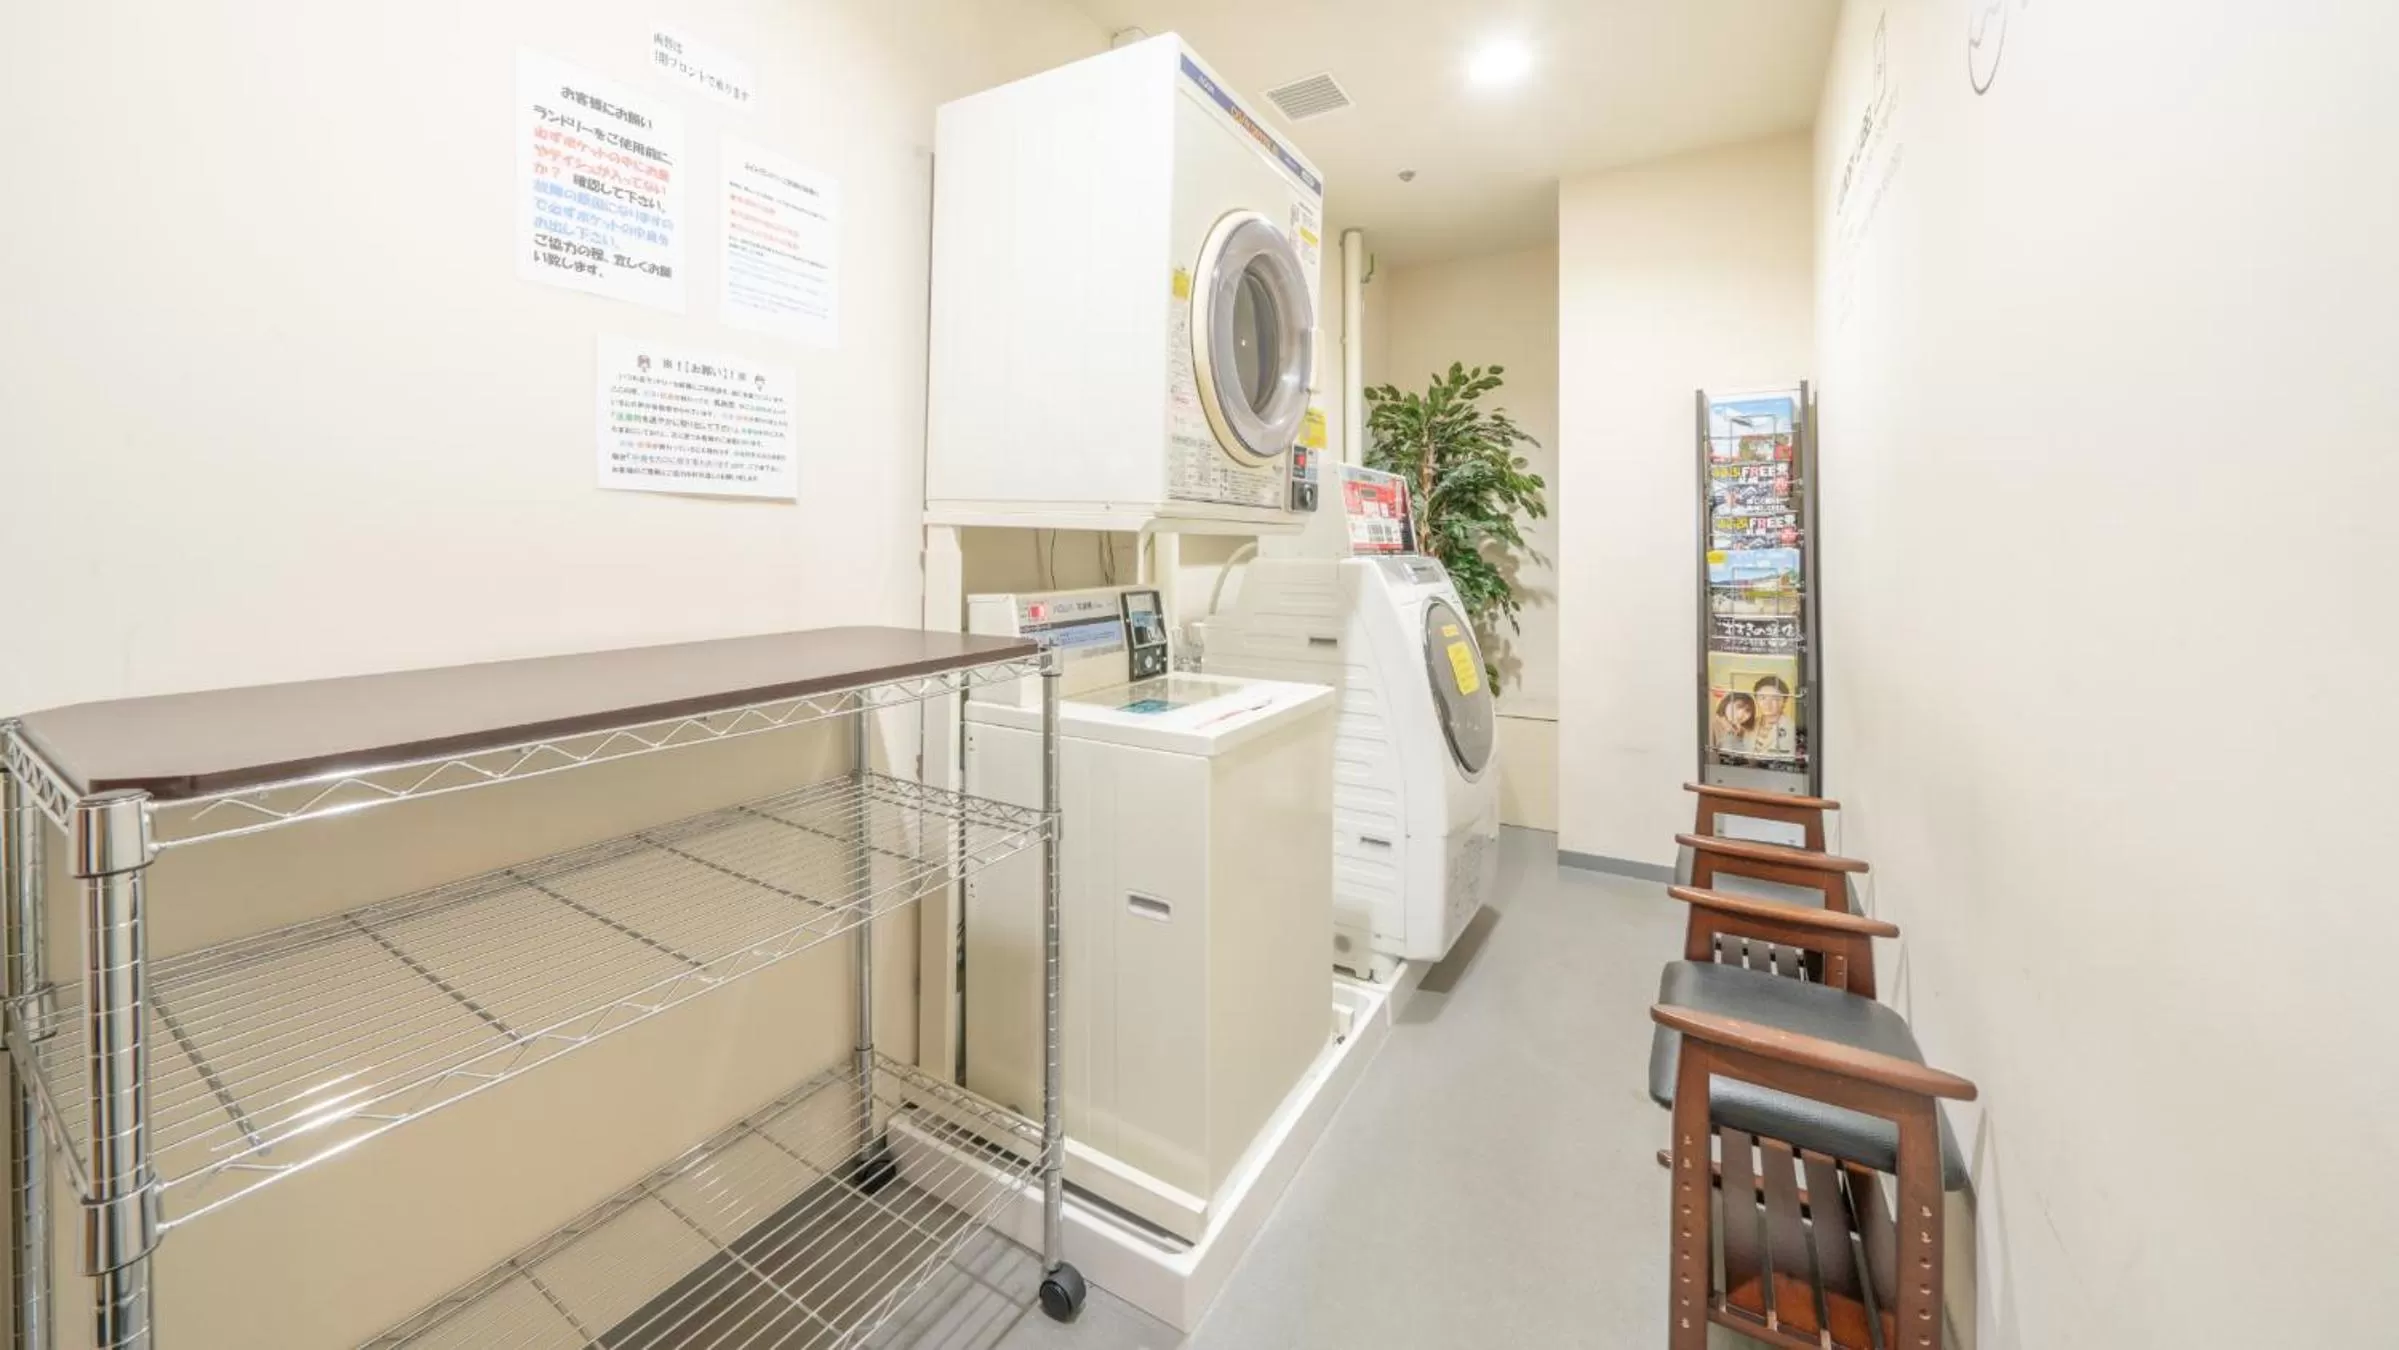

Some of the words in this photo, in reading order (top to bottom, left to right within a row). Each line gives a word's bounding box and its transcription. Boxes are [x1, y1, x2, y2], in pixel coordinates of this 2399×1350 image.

[560, 85, 653, 131] お客様にお願い
[532, 103, 674, 167] ランドリーをご使用前に
[533, 125, 671, 182] 必ずポケットの中にお金
[532, 178, 675, 231] 故障の原因になりますの
[534, 195, 670, 248] で必ずポケットの中身を
[533, 215, 621, 249] お出し下さい。
[533, 250, 605, 278] い致します。
